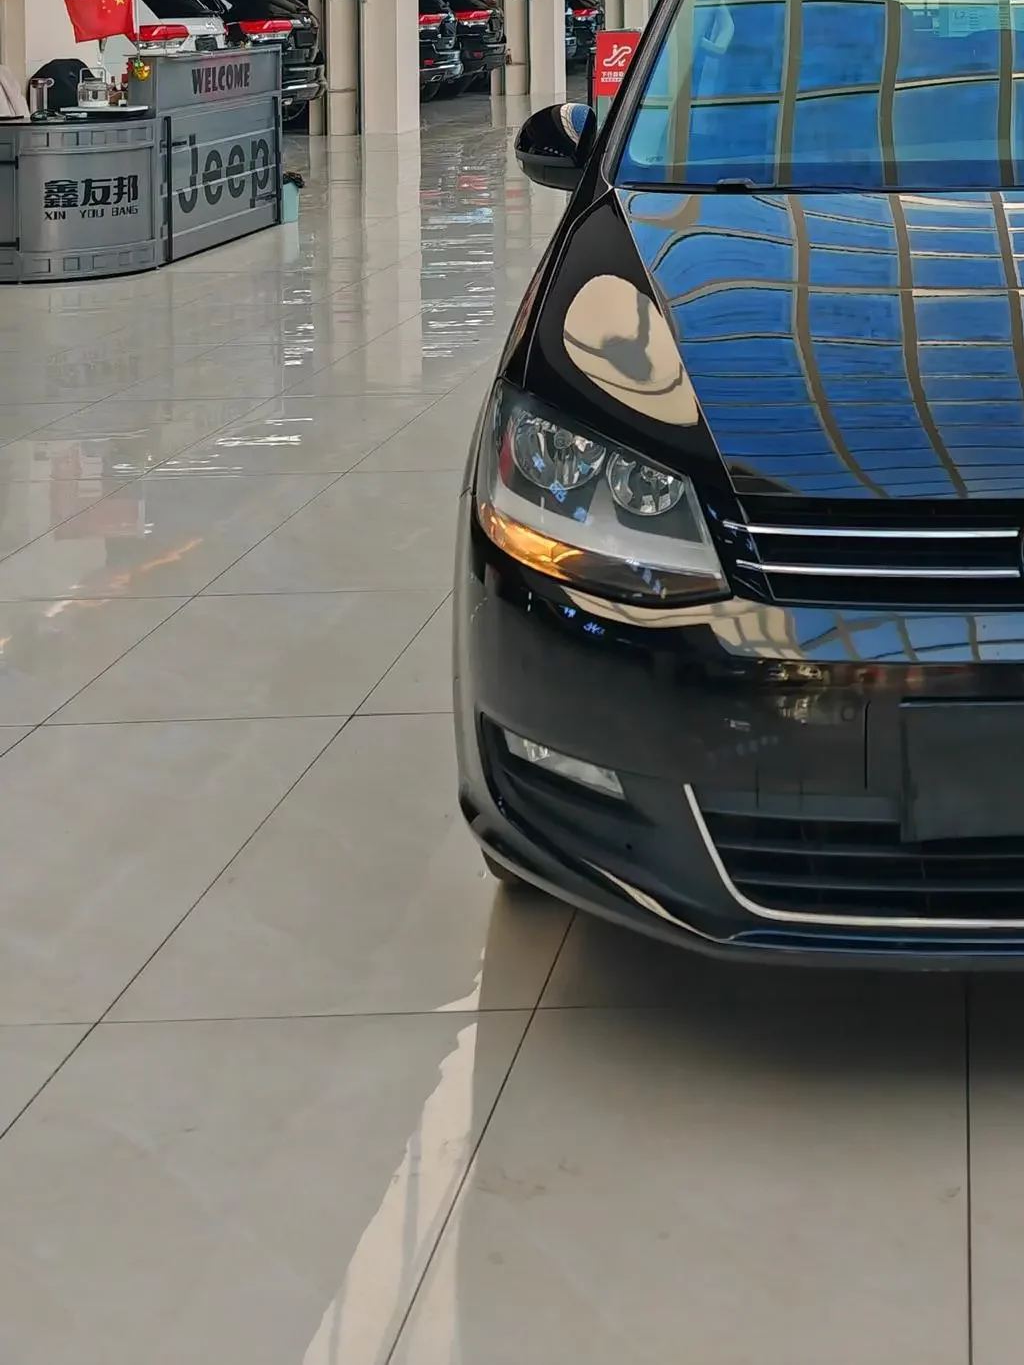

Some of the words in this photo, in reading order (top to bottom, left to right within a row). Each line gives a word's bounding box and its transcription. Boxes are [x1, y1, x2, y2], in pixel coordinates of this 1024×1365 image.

[192, 63, 250, 94] WELCOME
[178, 134, 270, 214] Jeep
[44, 175, 138, 208] 鑫友邦
[44, 211, 66, 221] XIN
[80, 208, 104, 218] YOU
[111, 206, 138, 217] BANG
